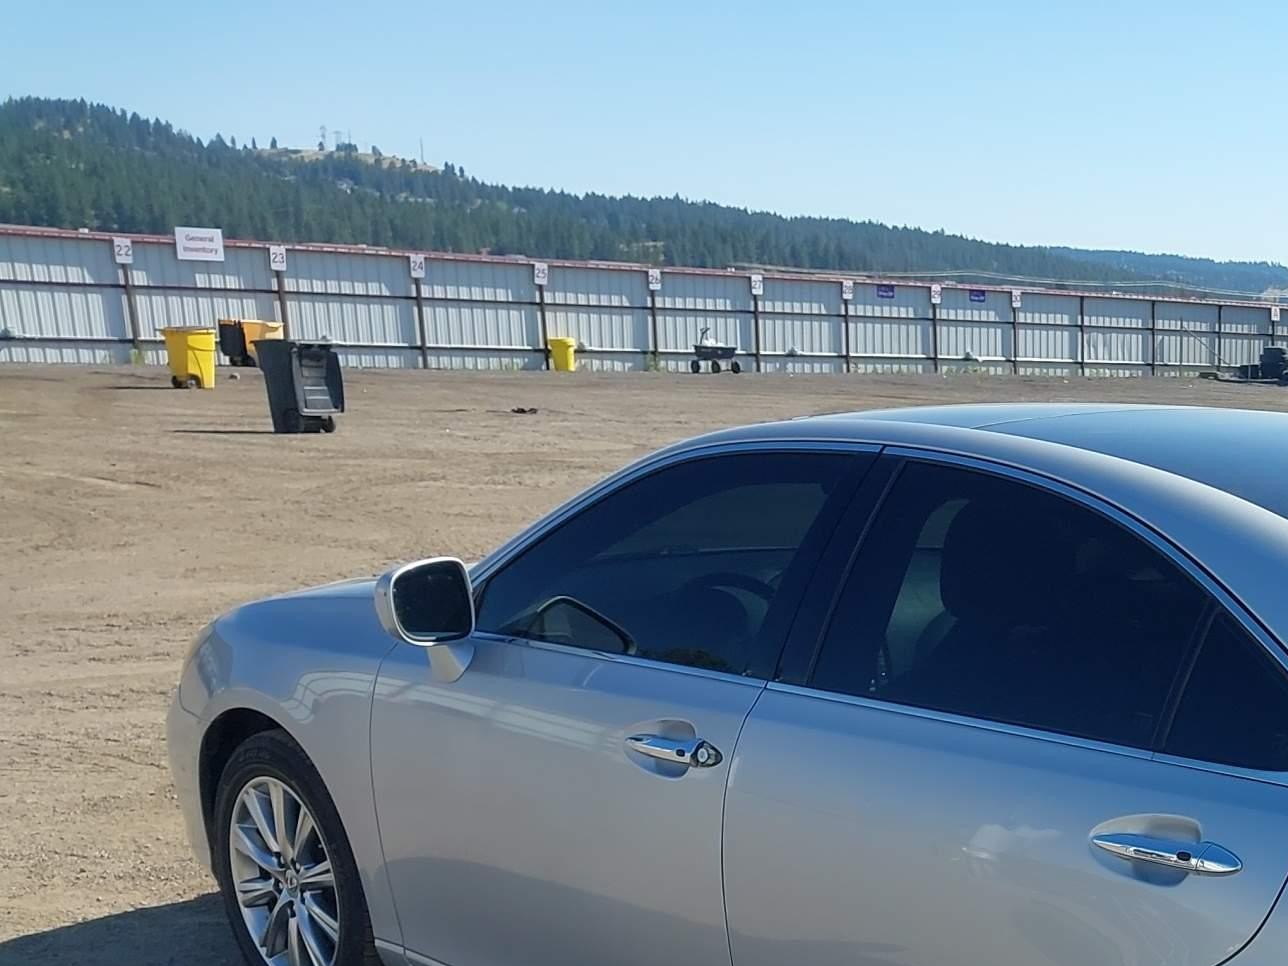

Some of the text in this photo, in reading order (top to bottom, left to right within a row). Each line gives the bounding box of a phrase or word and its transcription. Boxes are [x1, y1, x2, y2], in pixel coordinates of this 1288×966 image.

[184, 233, 214, 243] General
[116, 244, 131, 257] 22
[271, 252, 285, 264] 23
[411, 260, 424, 272] 24
[535, 268, 548, 279] 25
[752, 280, 763, 290] 27
